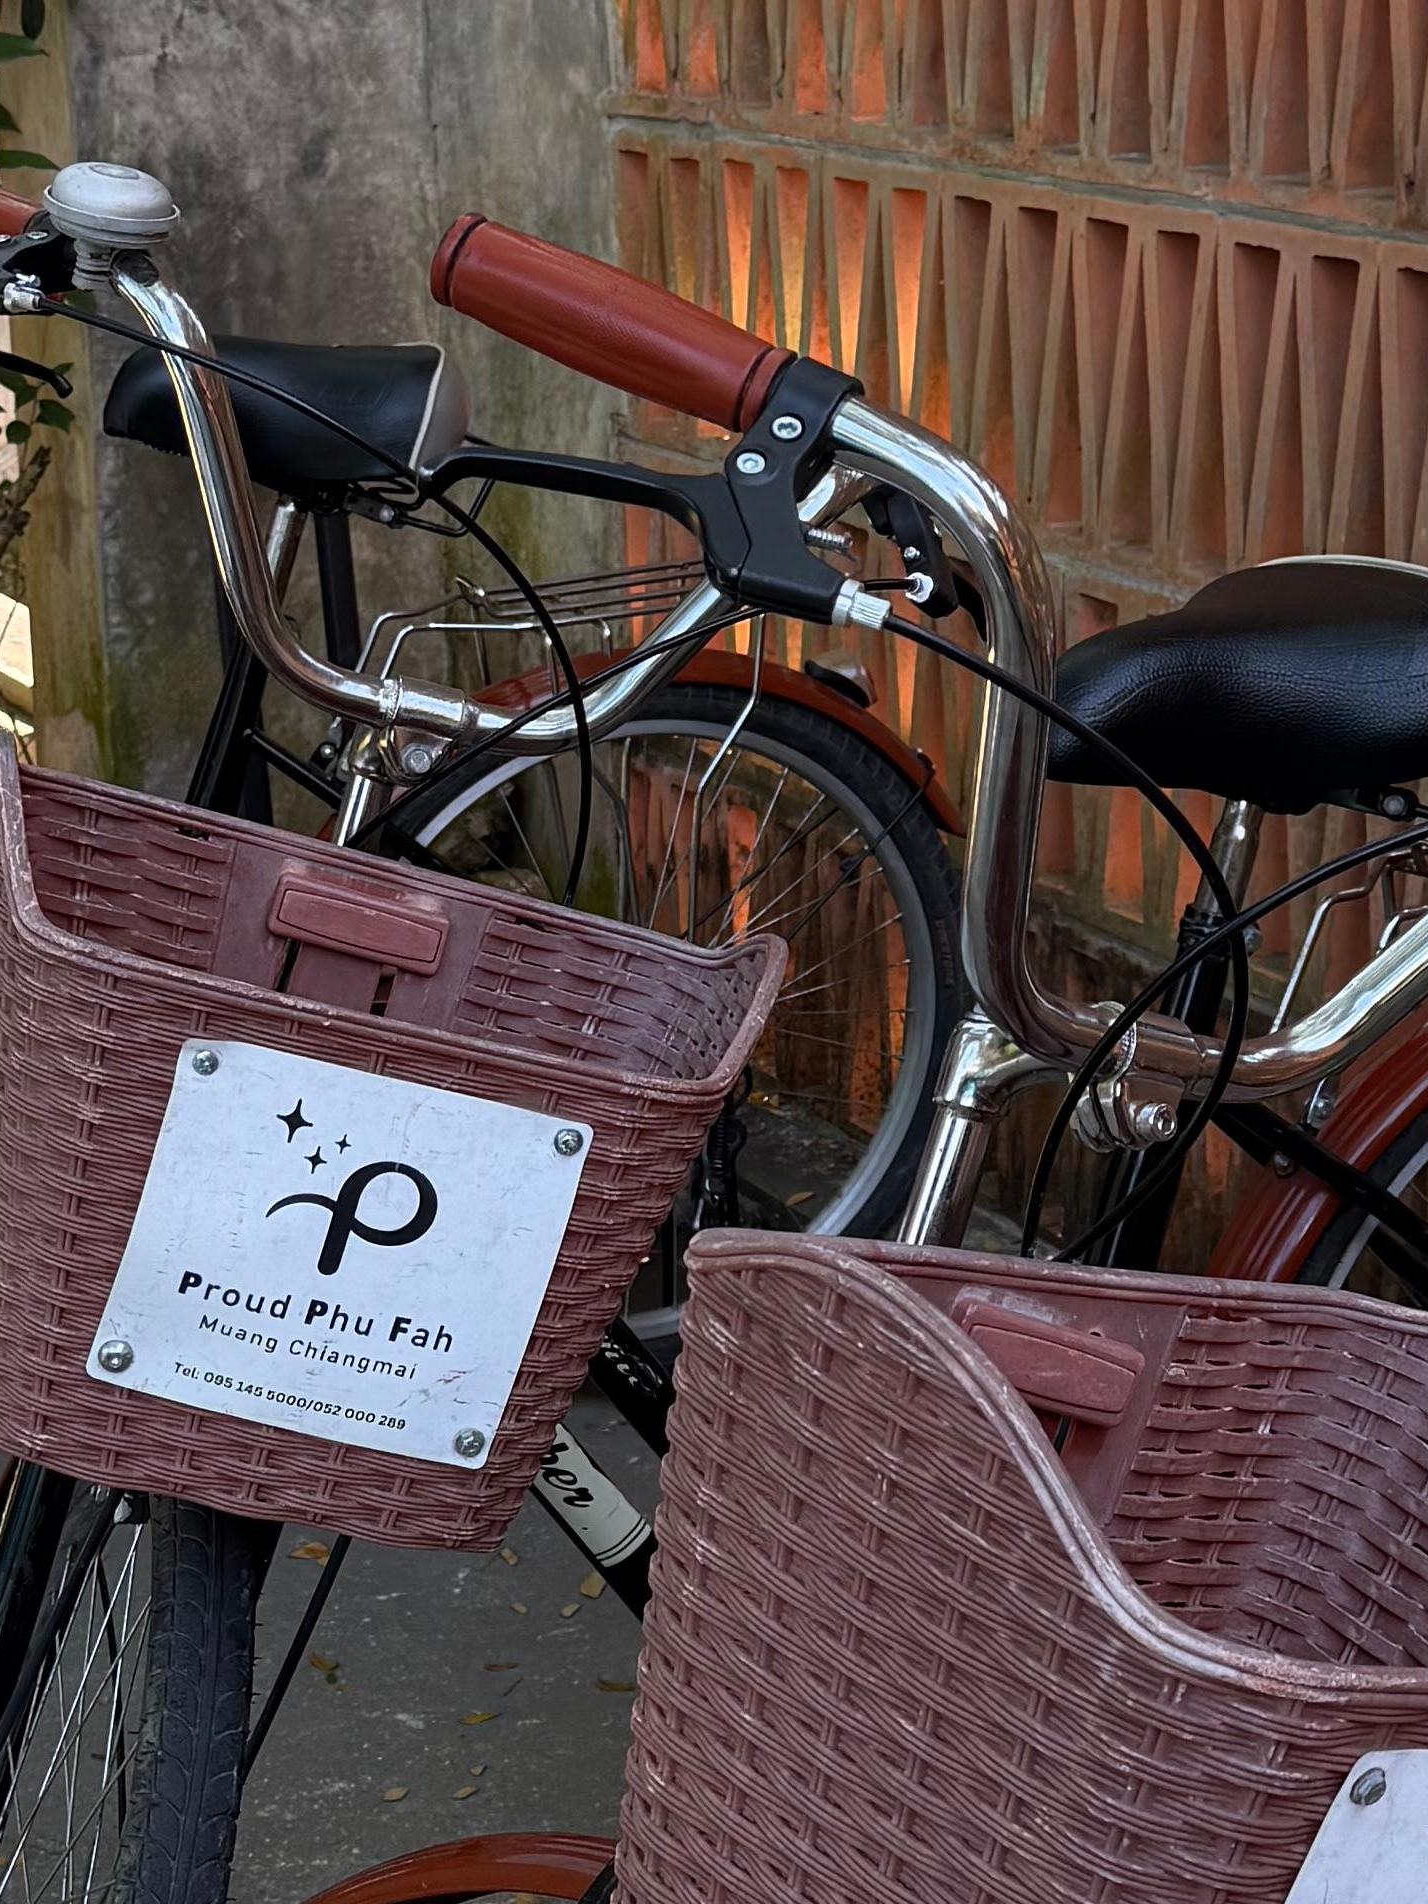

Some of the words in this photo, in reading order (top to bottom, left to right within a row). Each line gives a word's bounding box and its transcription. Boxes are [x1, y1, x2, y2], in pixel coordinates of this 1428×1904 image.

[177, 1270, 292, 1320] Proud
[304, 1298, 374, 1337] Phu
[388, 1316, 453, 1353] Fah
[198, 1314, 278, 1354] Muang
[289, 1339, 419, 1380] Chiangmai
[174, 1361, 200, 1380] Tel:
[203, 1372, 234, 1389] 095
[235, 1381, 263, 1397] 145
[266, 1389, 342, 1416] 5000/052
[344, 1408, 376, 1424] 000
[378, 1415, 406, 1430] 289
